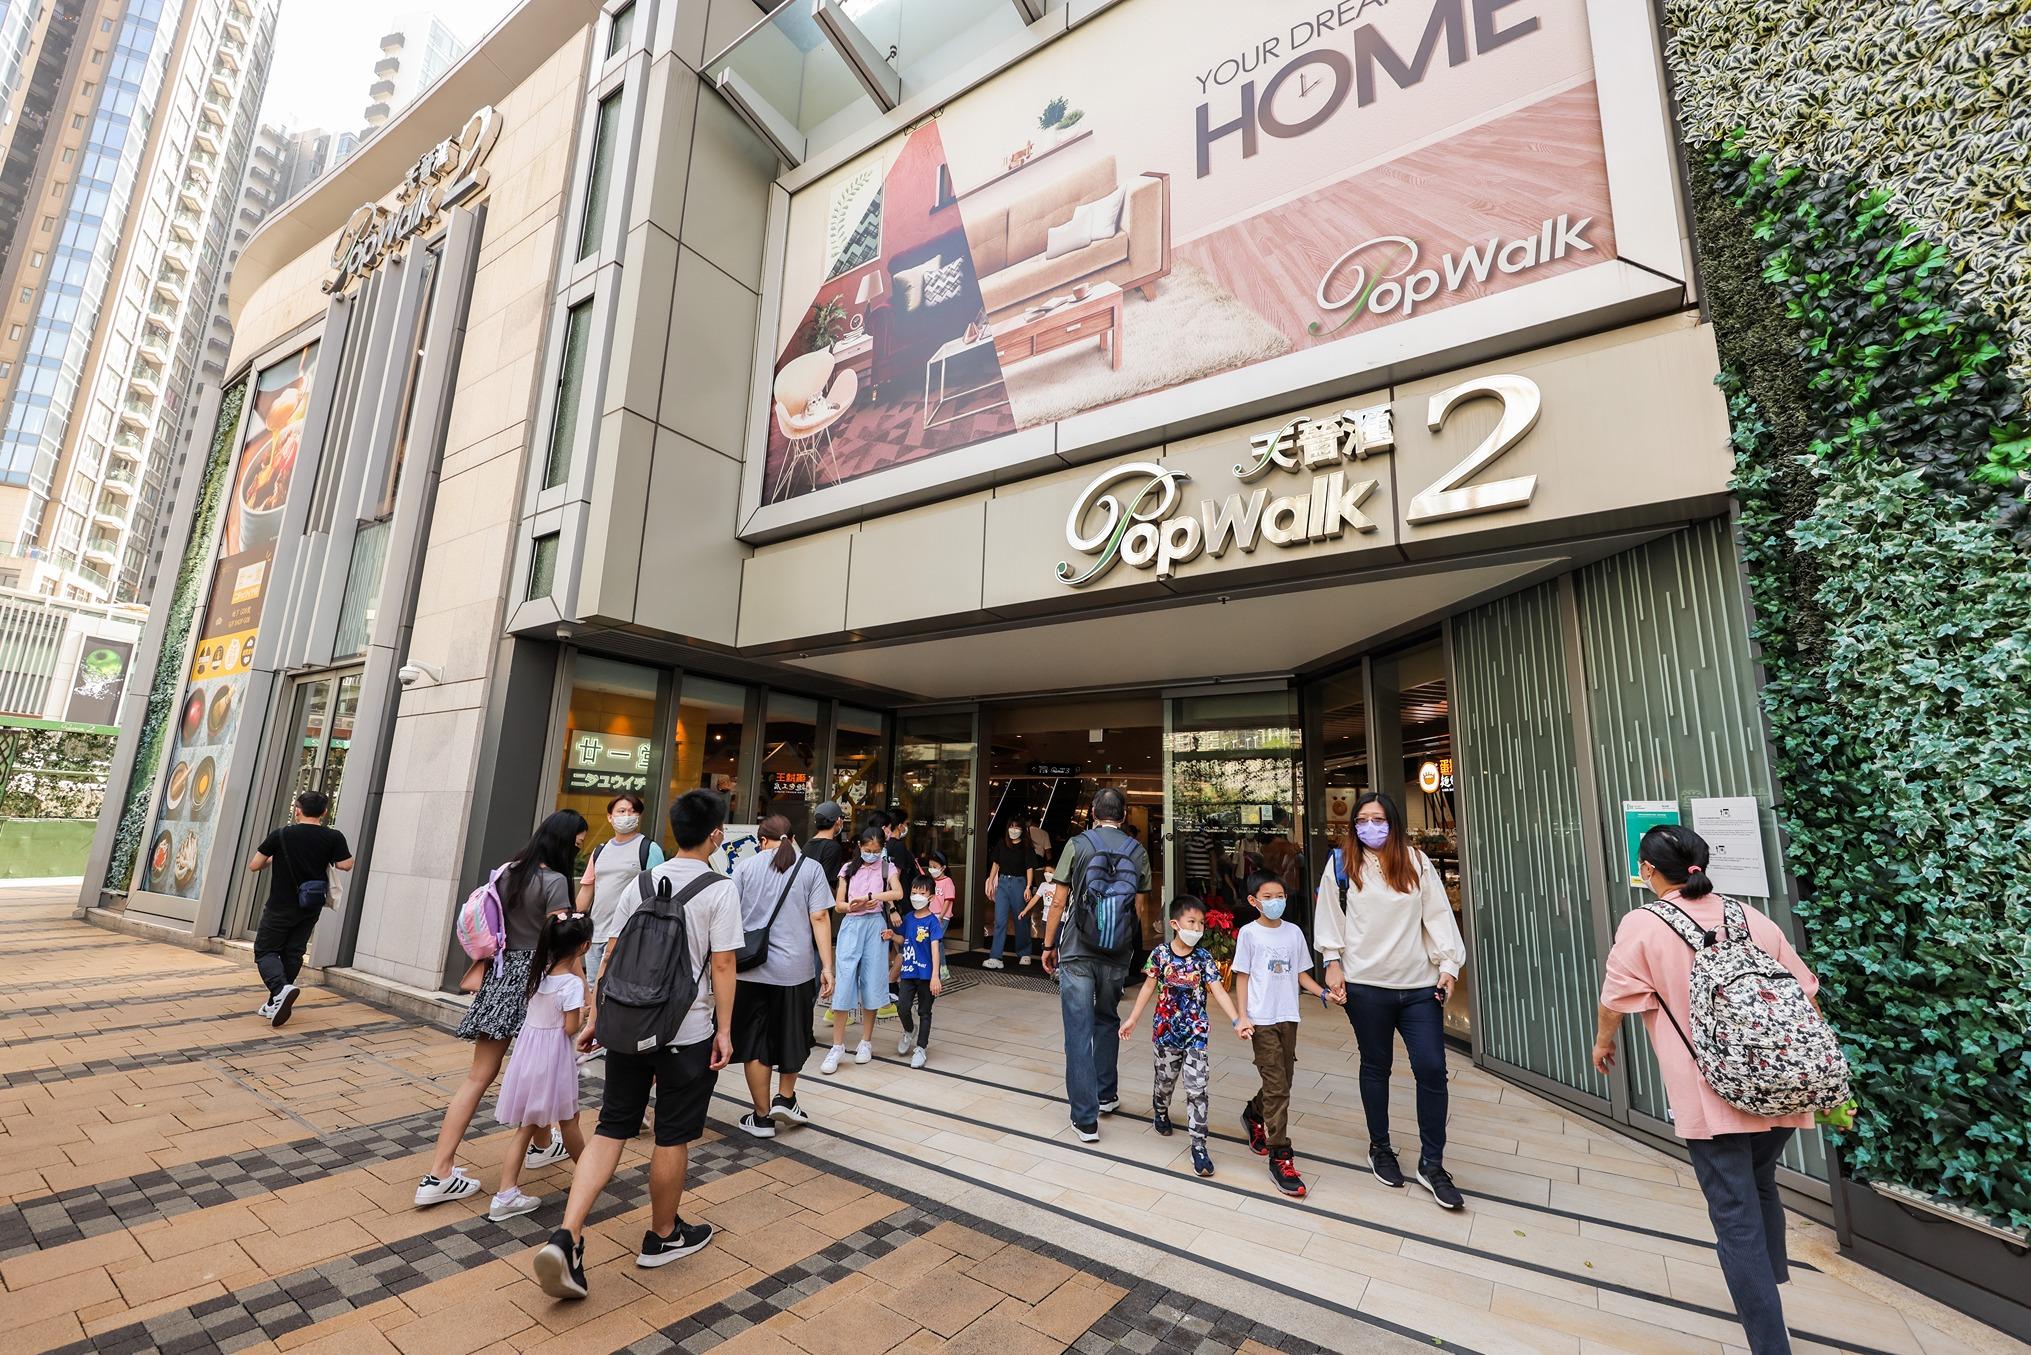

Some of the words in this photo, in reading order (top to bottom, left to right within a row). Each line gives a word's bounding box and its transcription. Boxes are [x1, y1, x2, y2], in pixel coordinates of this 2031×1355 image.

[1196, 37, 1281, 94] YOUR
[1290, 0, 1390, 51] DREA
[1196, 0, 1538, 179] HOME
[441, 105, 504, 210] 2
[1308, 213, 1594, 337] PopWalk
[1055, 461, 1381, 588] PopWalk
[1407, 373, 1543, 526] 2
